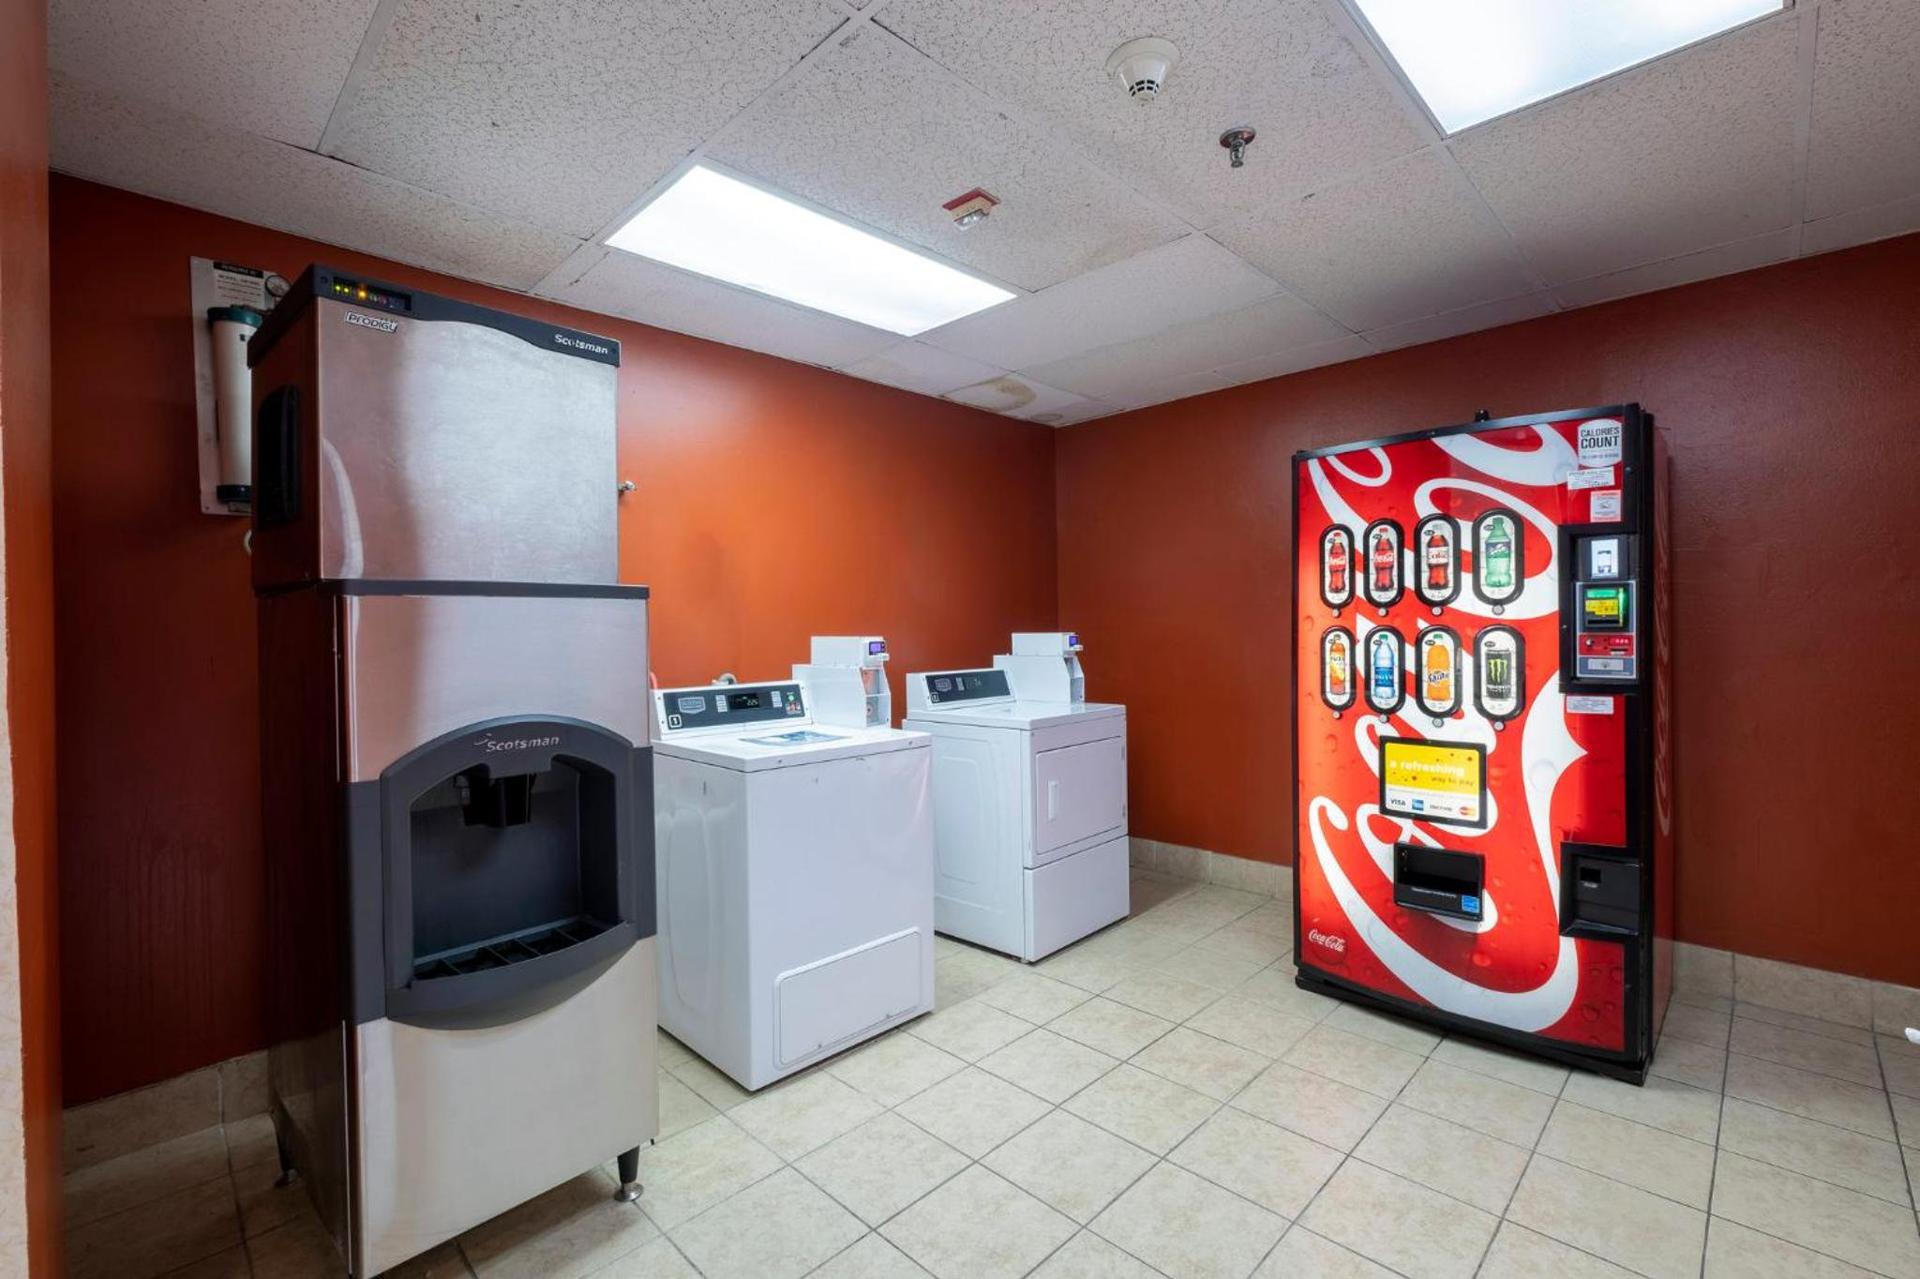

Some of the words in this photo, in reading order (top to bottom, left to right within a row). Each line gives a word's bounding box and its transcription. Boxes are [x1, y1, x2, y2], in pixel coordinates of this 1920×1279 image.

[554, 333, 608, 354] Scotsman
[1580, 427, 1620, 438] CALORIES
[1580, 436, 1620, 449] COUNT
[486, 736, 560, 752] Scotsman
[1401, 760, 1466, 778] refreshing
[1390, 799, 1406, 807] VISA
